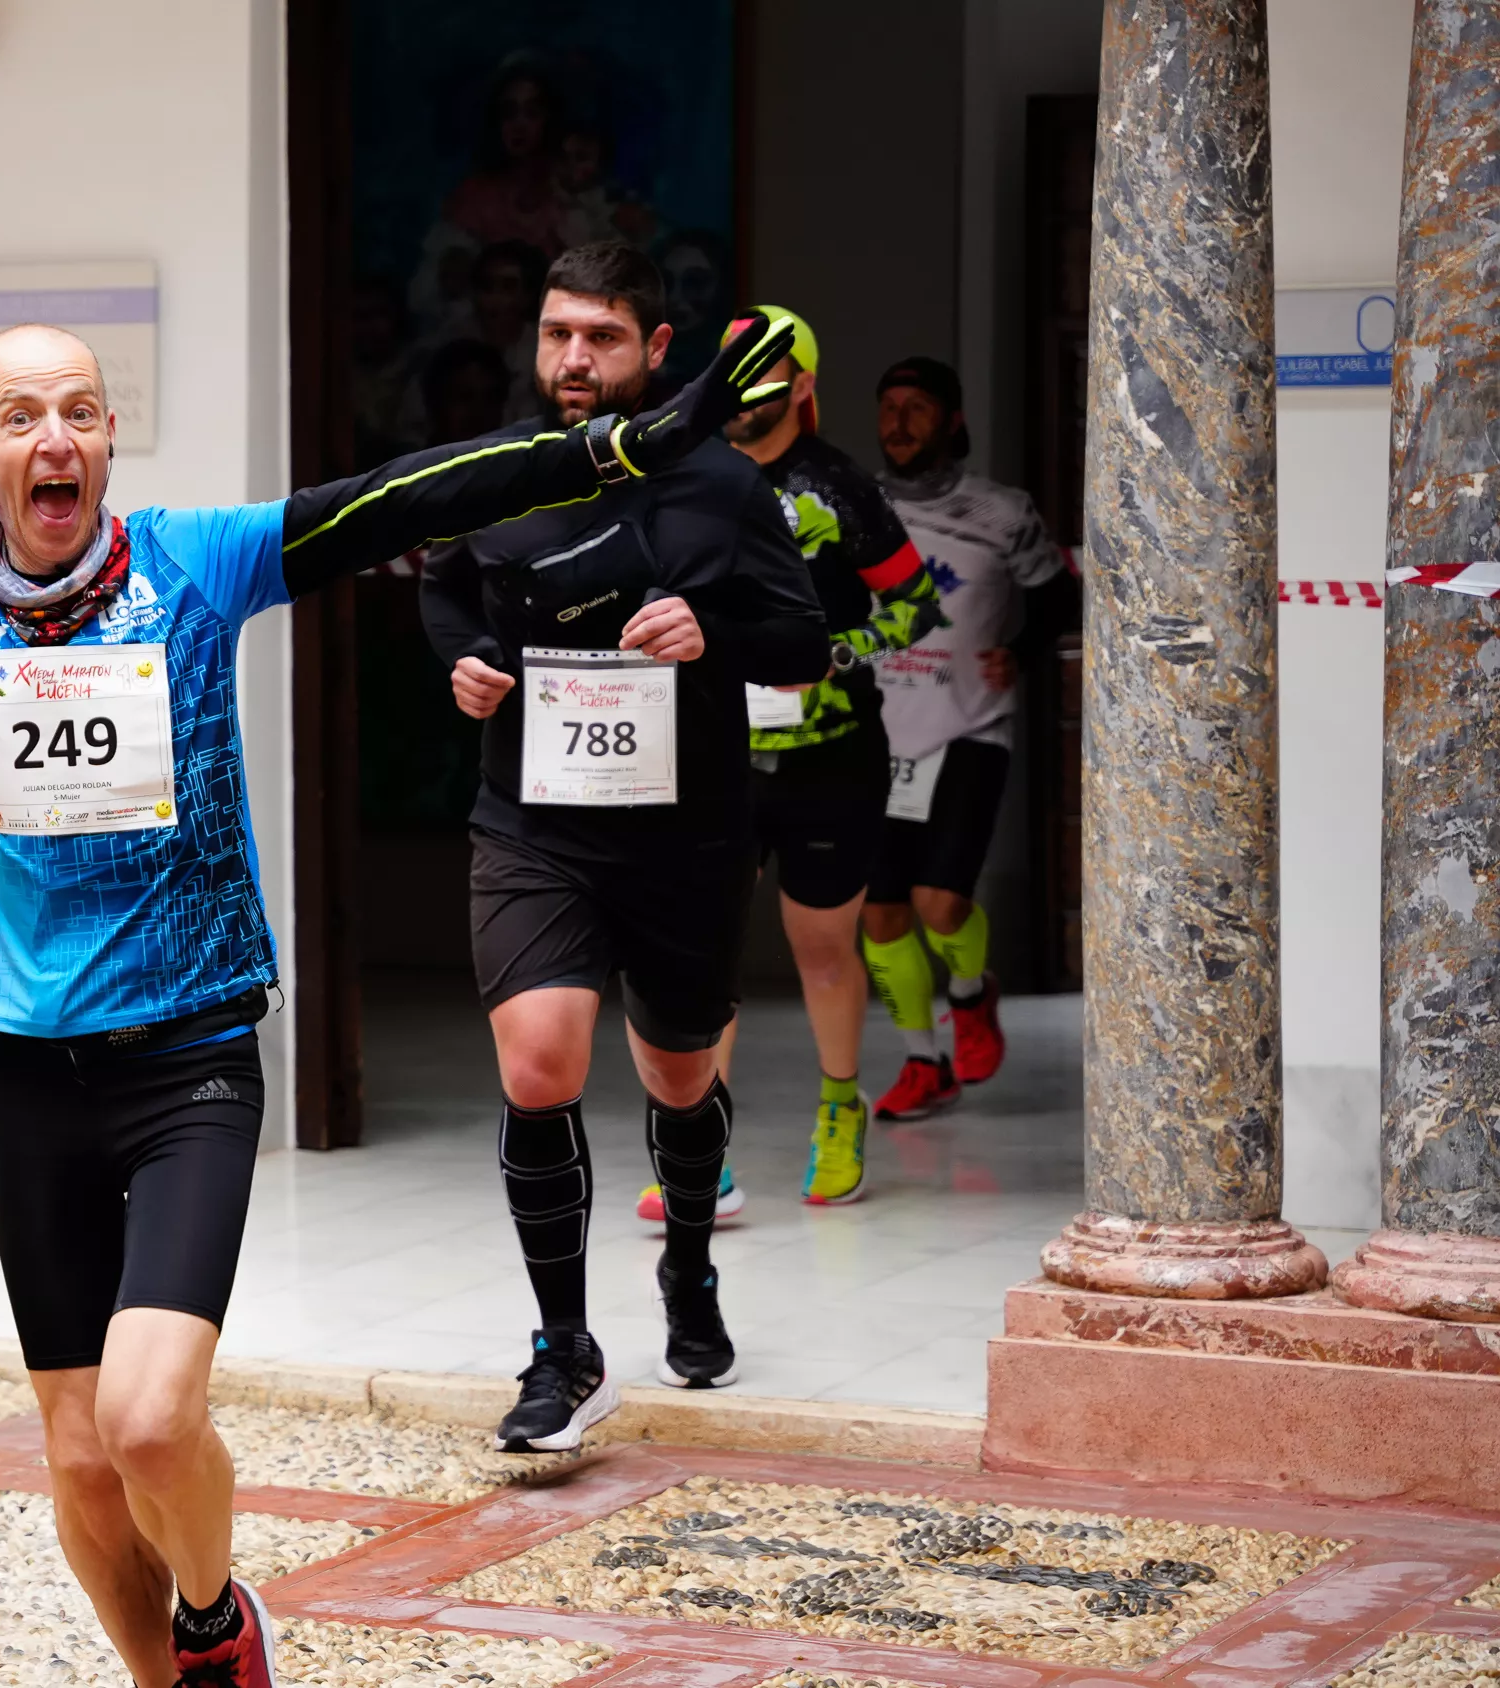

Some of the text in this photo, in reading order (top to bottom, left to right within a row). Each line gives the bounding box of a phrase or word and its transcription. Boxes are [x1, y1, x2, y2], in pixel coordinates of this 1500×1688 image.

[36, 682, 99, 700] LUCENA
[12, 716, 118, 769] 249
[562, 721, 637, 757] 788
[47, 783, 81, 791] DELGADO
[82, 781, 112, 789] ROLDAN
[191, 1089, 239, 1100] adidas
